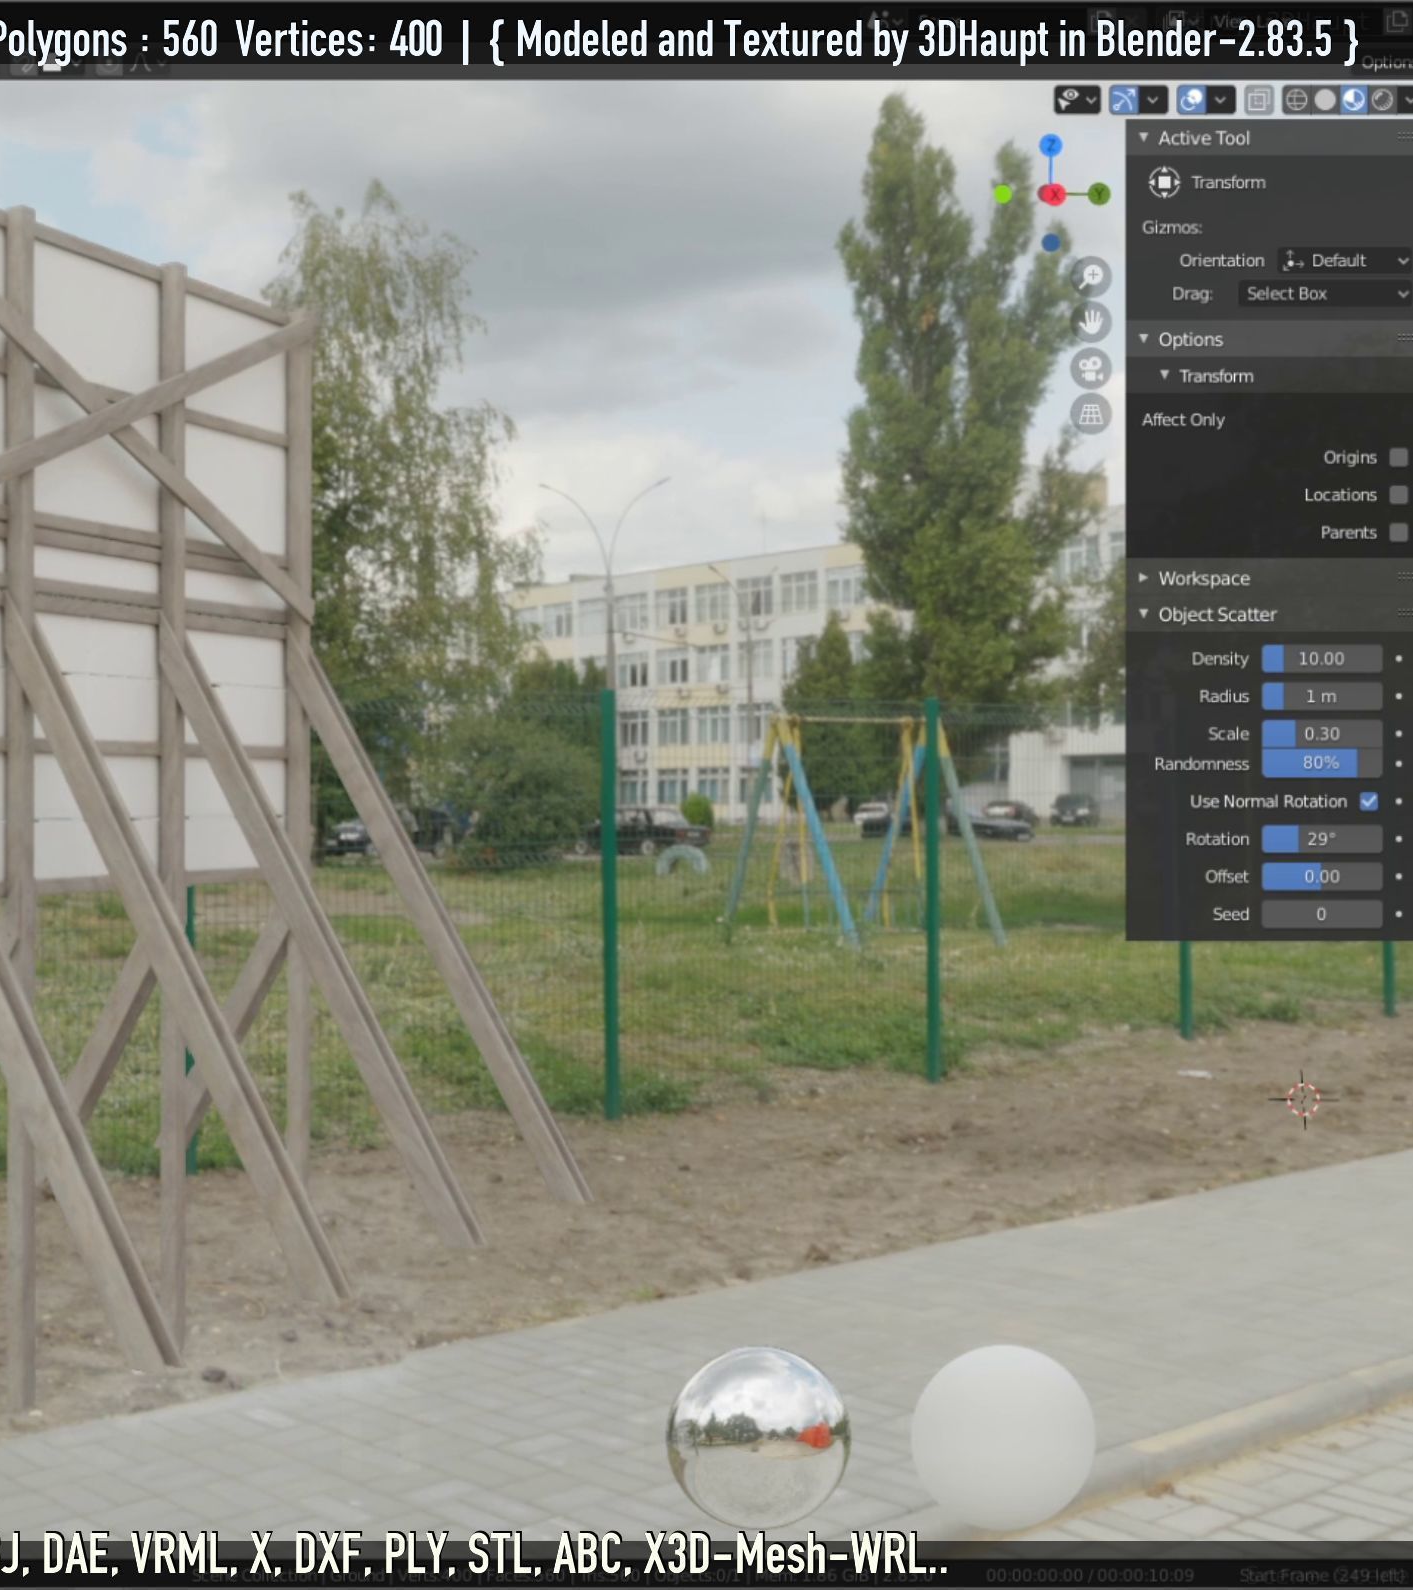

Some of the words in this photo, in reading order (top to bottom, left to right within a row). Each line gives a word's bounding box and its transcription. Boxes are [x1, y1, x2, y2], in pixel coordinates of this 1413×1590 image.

[1159, 130, 1211, 146] Active
[1213, 130, 1250, 146] Tool
[1191, 175, 1267, 190] Transform
[1142, 220, 1203, 235] Gizmos:
[1180, 253, 1265, 268] Orientation
[1312, 253, 1367, 268] Default
[1172, 286, 1214, 304] Drag:
[1247, 286, 1295, 301] Select
[1299, 286, 1328, 301] Box
[1159, 331, 1224, 350] Options
[1179, 368, 1254, 384] Transform
[1142, 412, 1187, 427] Affect
[1190, 412, 1226, 431] Only
[1324, 450, 1378, 468] Origins
[1305, 488, 1378, 502] Locations
[1321, 525, 1378, 540] Parents
[1159, 570, 1251, 589] Workspace
[1159, 606, 1213, 625] Object
[1217, 606, 1277, 622] Scatter
[1192, 651, 1250, 669] Density
[1299, 651, 1345, 666] 10.00
[1199, 689, 1250, 704] Radius
[1306, 689, 1316, 703] 1
[1321, 692, 1338, 703] m
[1208, 726, 1250, 741] Scale
[1304, 726, 1340, 741] 0.30
[1155, 757, 1250, 771] Randomness
[1303, 755, 1340, 770] 80%
[1190, 794, 1220, 809] Use
[1224, 794, 1279, 809] Normal
[1283, 794, 1348, 809] Rotation
[1186, 832, 1250, 847] Rotation
[1307, 831, 1337, 847] 29°
[1205, 869, 1250, 884] Offset
[1304, 869, 1340, 884] 0.00
[1213, 906, 1250, 921] Seed
[1316, 907, 1327, 921] 0
[986, 1568, 1083, 1583] 00:00:00:00
[1097, 1568, 1195, 1583] 00:00:10:09
